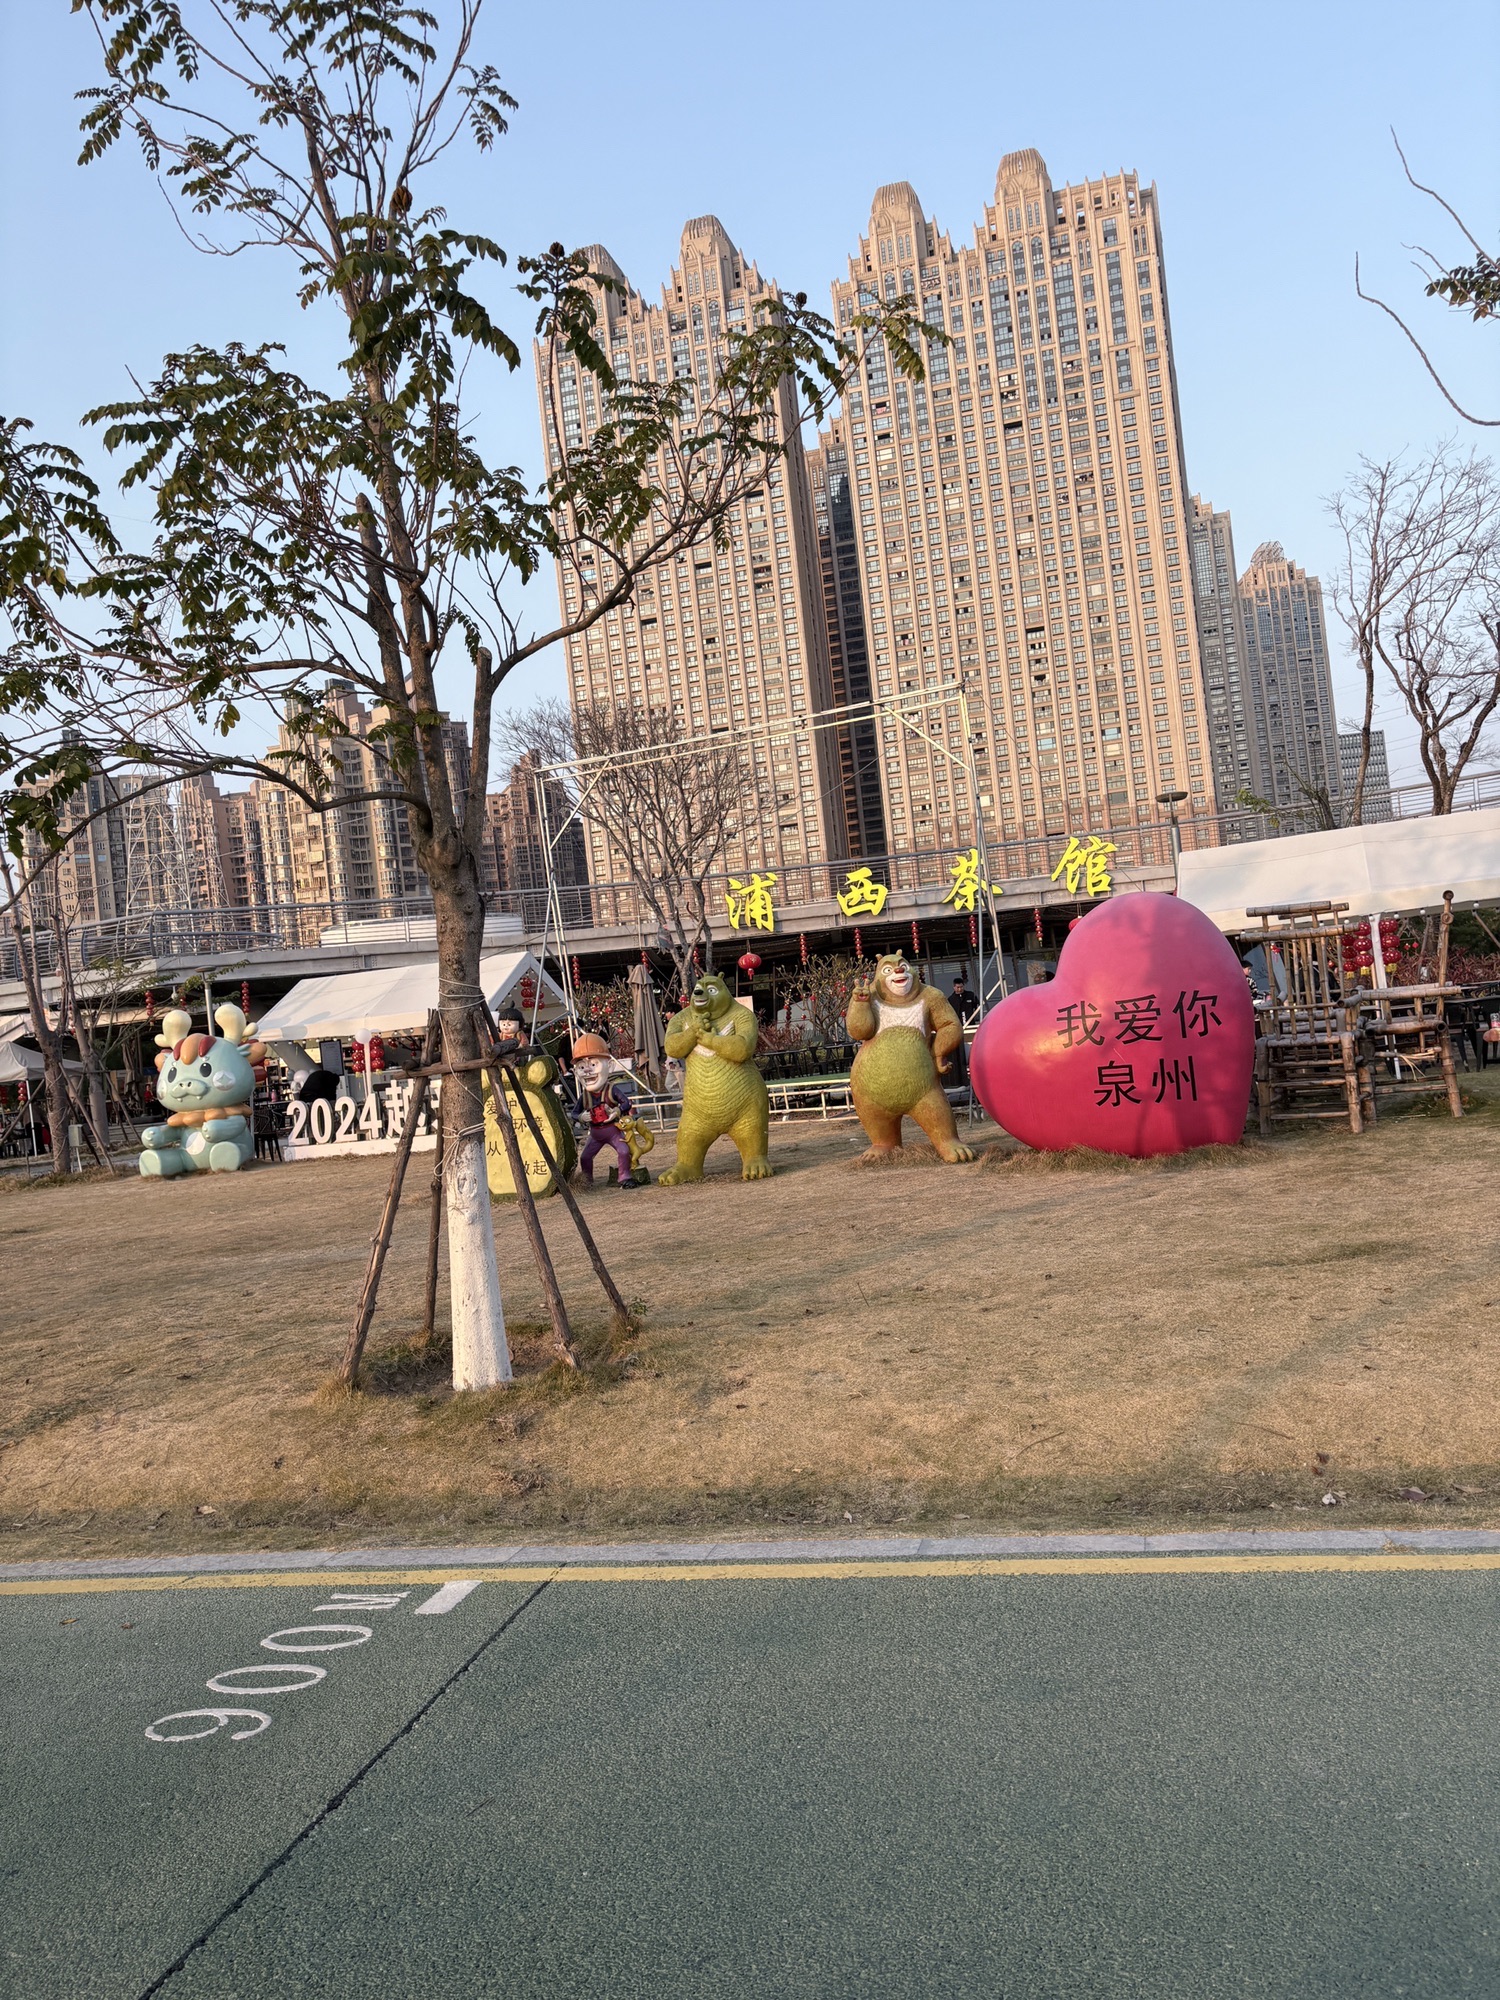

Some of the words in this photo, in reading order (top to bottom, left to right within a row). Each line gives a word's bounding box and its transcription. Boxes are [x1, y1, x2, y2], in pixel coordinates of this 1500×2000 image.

[724, 834, 1119, 933] 浦西茶馆
[1056, 990, 1223, 1049] 我爱你
[1094, 1055, 1200, 1107] 泉州
[144, 1590, 412, 1742] 900M
